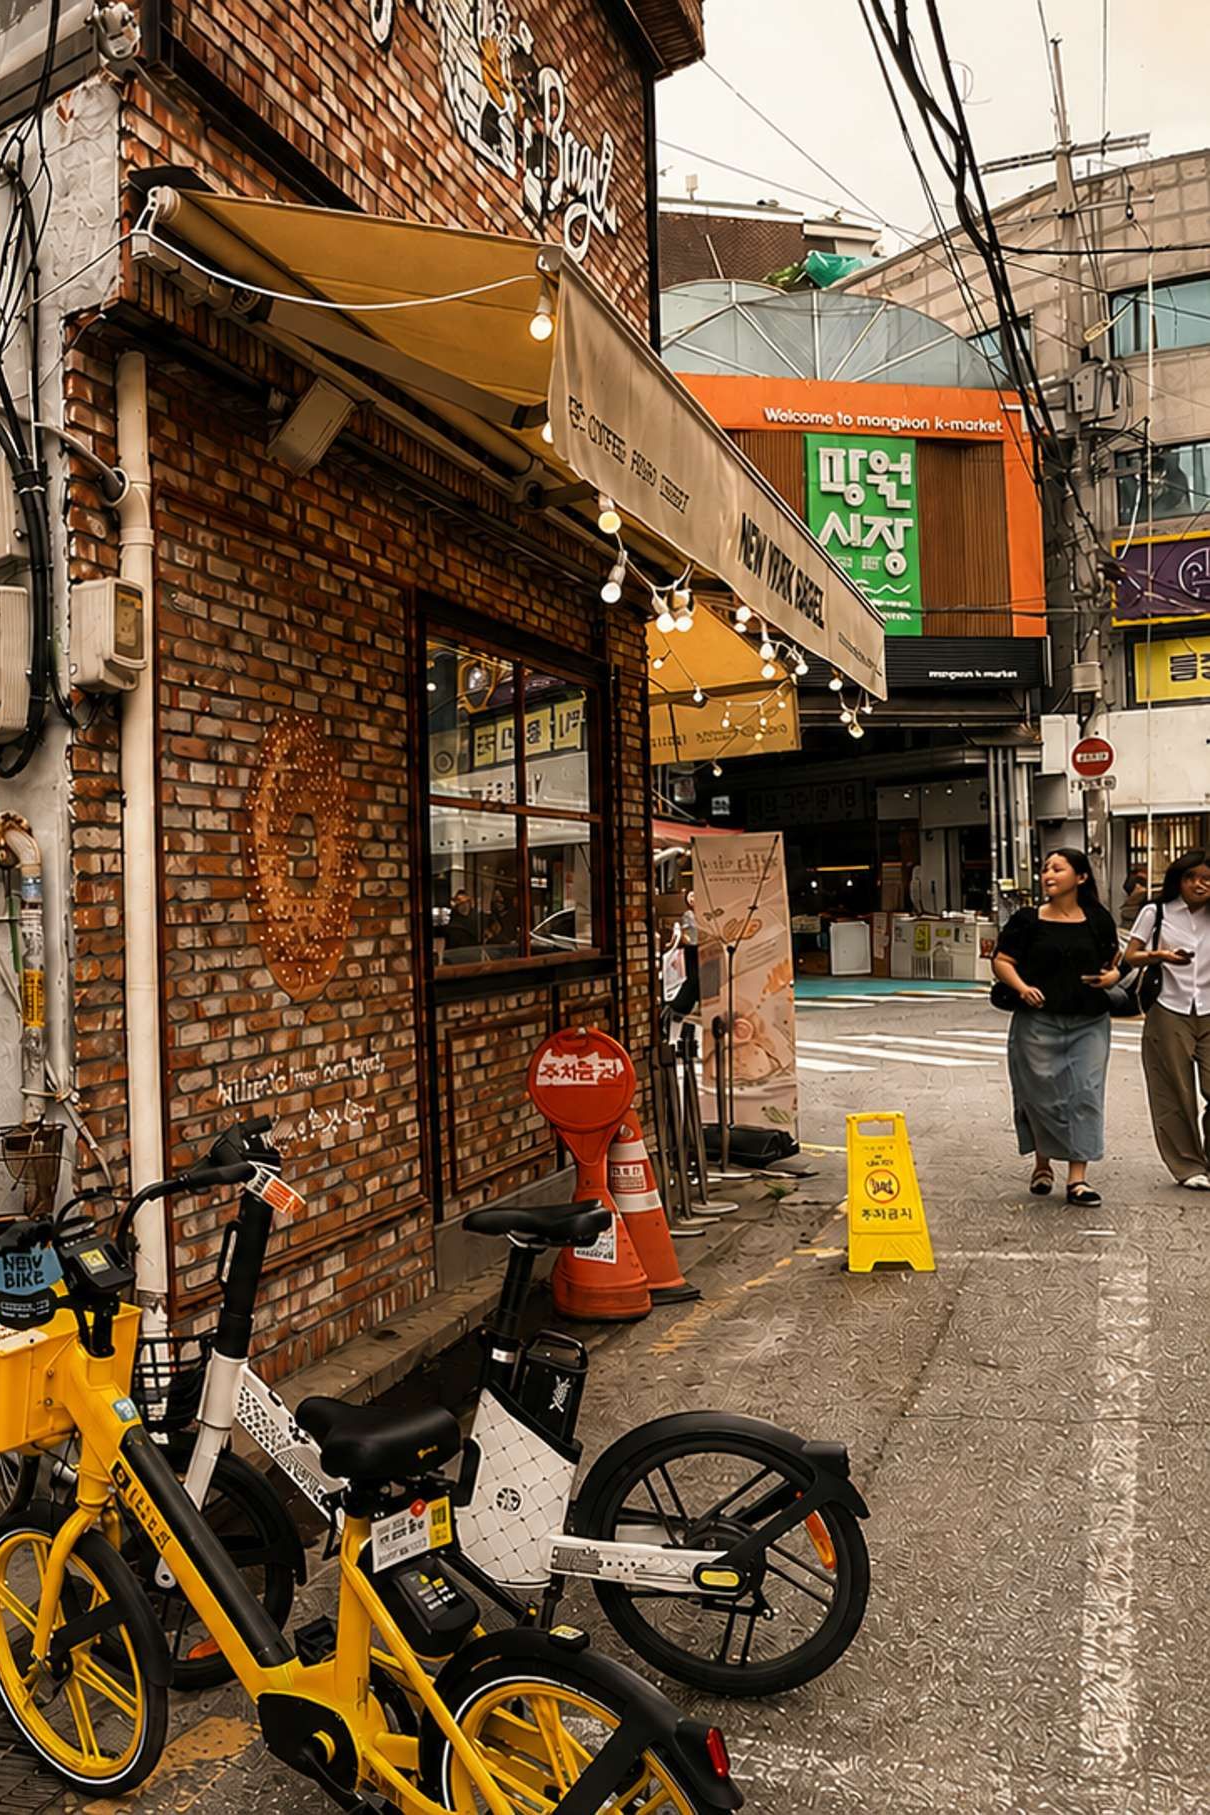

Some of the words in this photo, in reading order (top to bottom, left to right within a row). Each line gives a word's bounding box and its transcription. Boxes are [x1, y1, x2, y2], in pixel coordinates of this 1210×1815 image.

[764, 408, 833, 425] Welcome
[837, 411, 853, 426] to
[857, 415, 930, 431] mangwon
[935, 416, 1003, 433] k-market
[818, 447, 912, 510] 망원
[818, 511, 914, 576] 시장
[4, 1271, 45, 1290] BIKE
